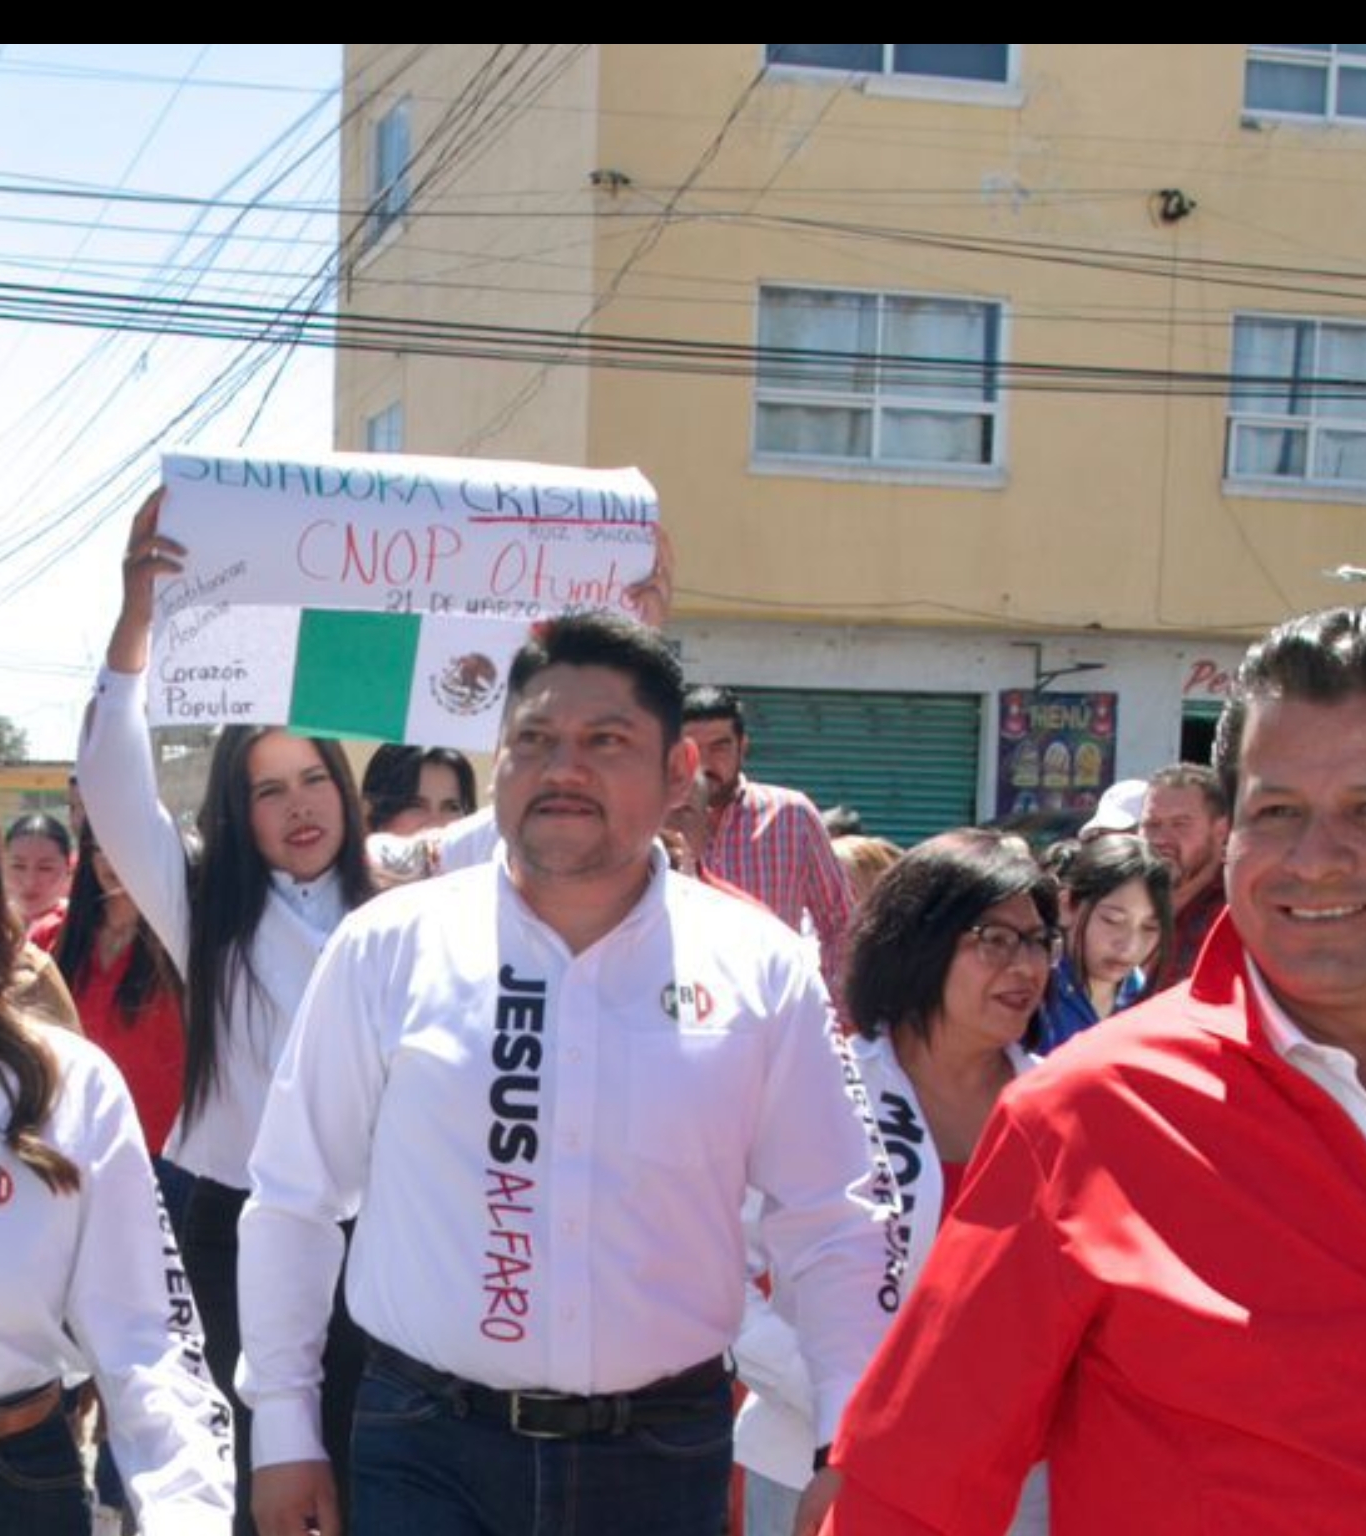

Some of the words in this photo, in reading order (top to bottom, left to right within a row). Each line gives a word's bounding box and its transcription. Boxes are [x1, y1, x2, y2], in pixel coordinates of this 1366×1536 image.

[297, 519, 463, 585] CNOP
[165, 686, 254, 717] Popular
[488, 963, 547, 1164] JESUS
[480, 1168, 534, 1342] ALFARO
